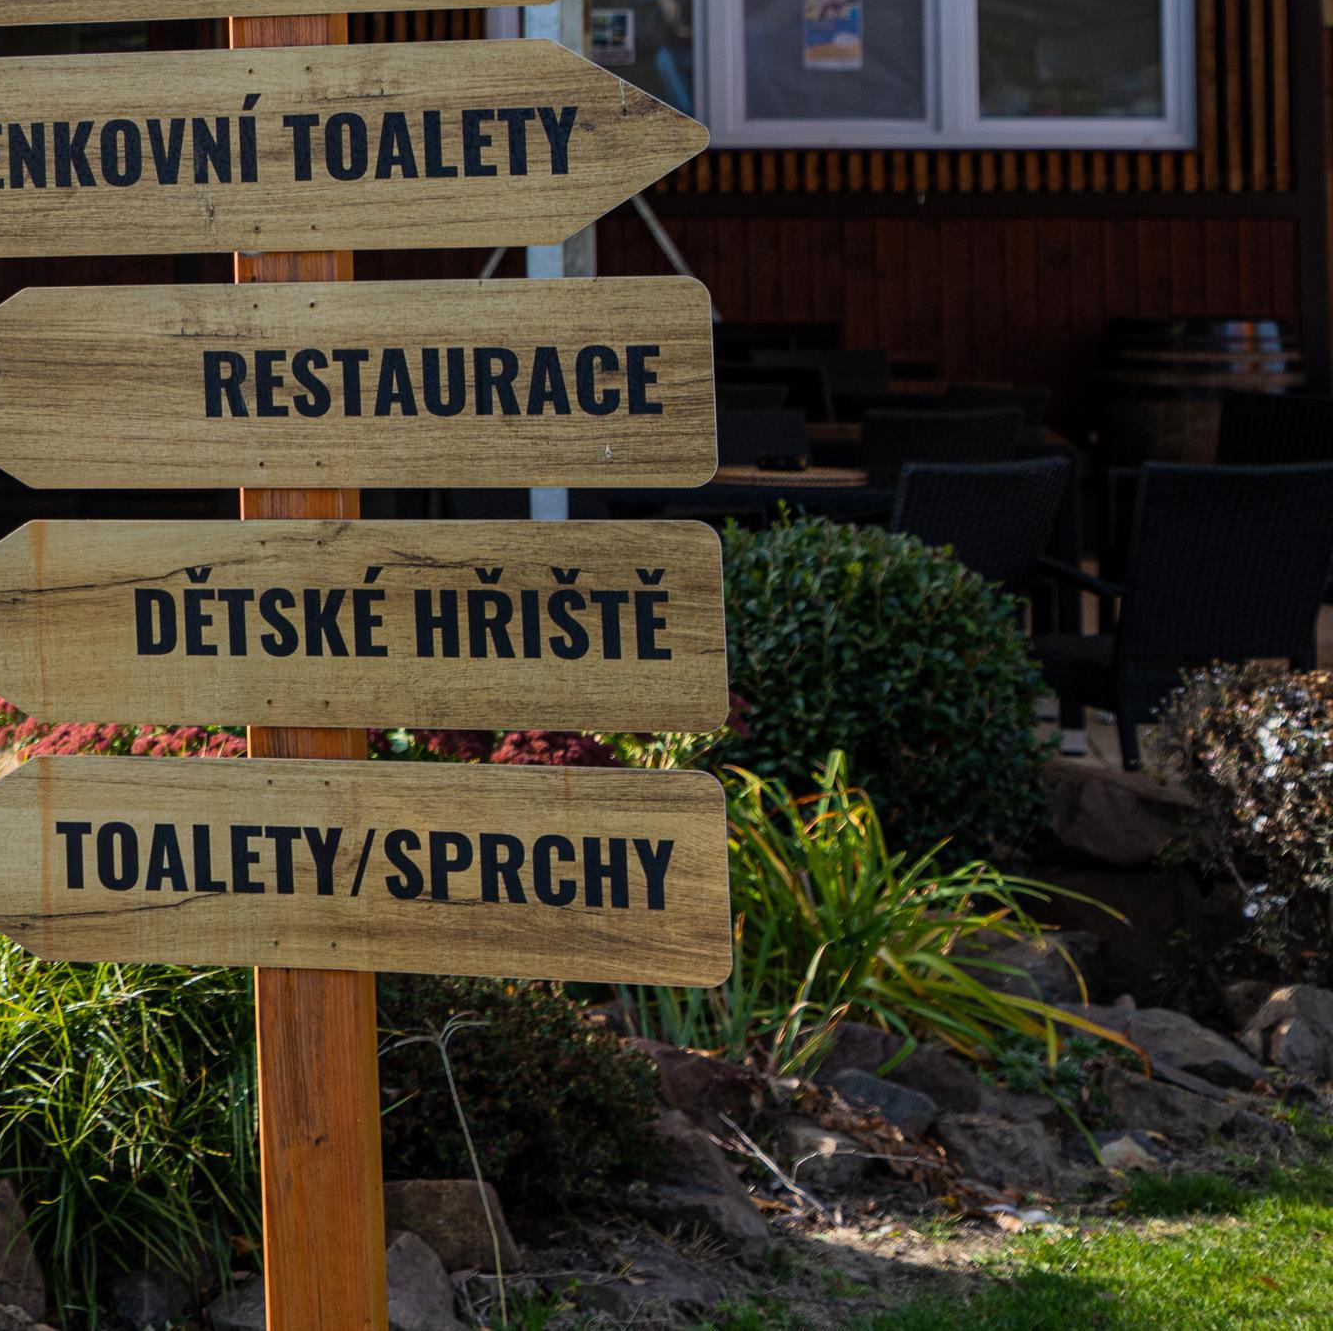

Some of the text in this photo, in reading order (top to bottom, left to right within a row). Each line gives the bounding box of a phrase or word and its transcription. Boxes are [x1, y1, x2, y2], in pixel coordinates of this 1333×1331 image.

[282, 105, 579, 182] TOALETY
[203, 344, 664, 418] RESTAURACE
[134, 566, 672, 661] DĚTSKÉ HŘIŠTĚ
[55, 821, 675, 911] TOALETY/SPRCHY
